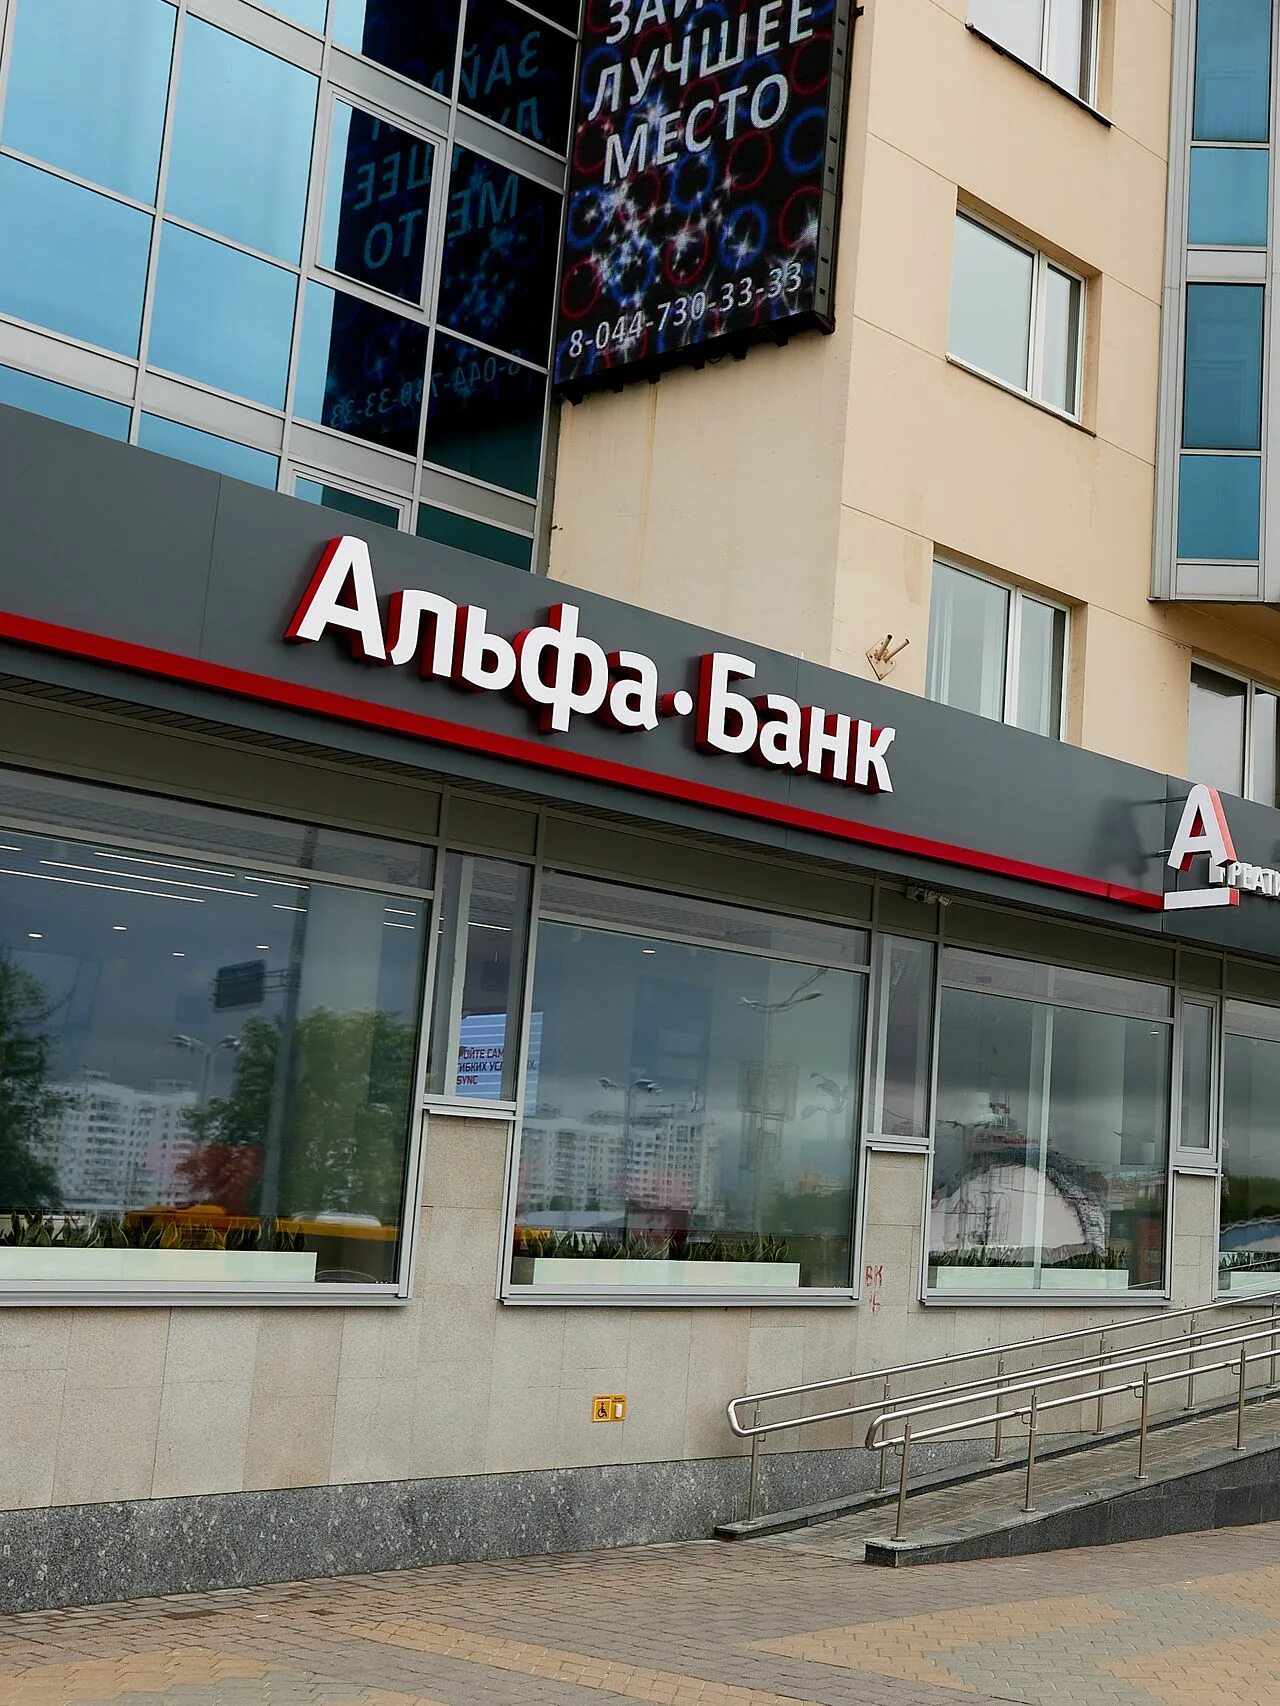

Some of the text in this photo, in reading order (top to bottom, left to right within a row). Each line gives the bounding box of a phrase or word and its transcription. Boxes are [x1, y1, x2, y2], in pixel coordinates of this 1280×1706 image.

[588, 0, 814, 121] ЛУЧШЕЕ
[603, 74, 788, 184] МЕСТО
[568, 262, 802, 358] 8-044-730-33-33
